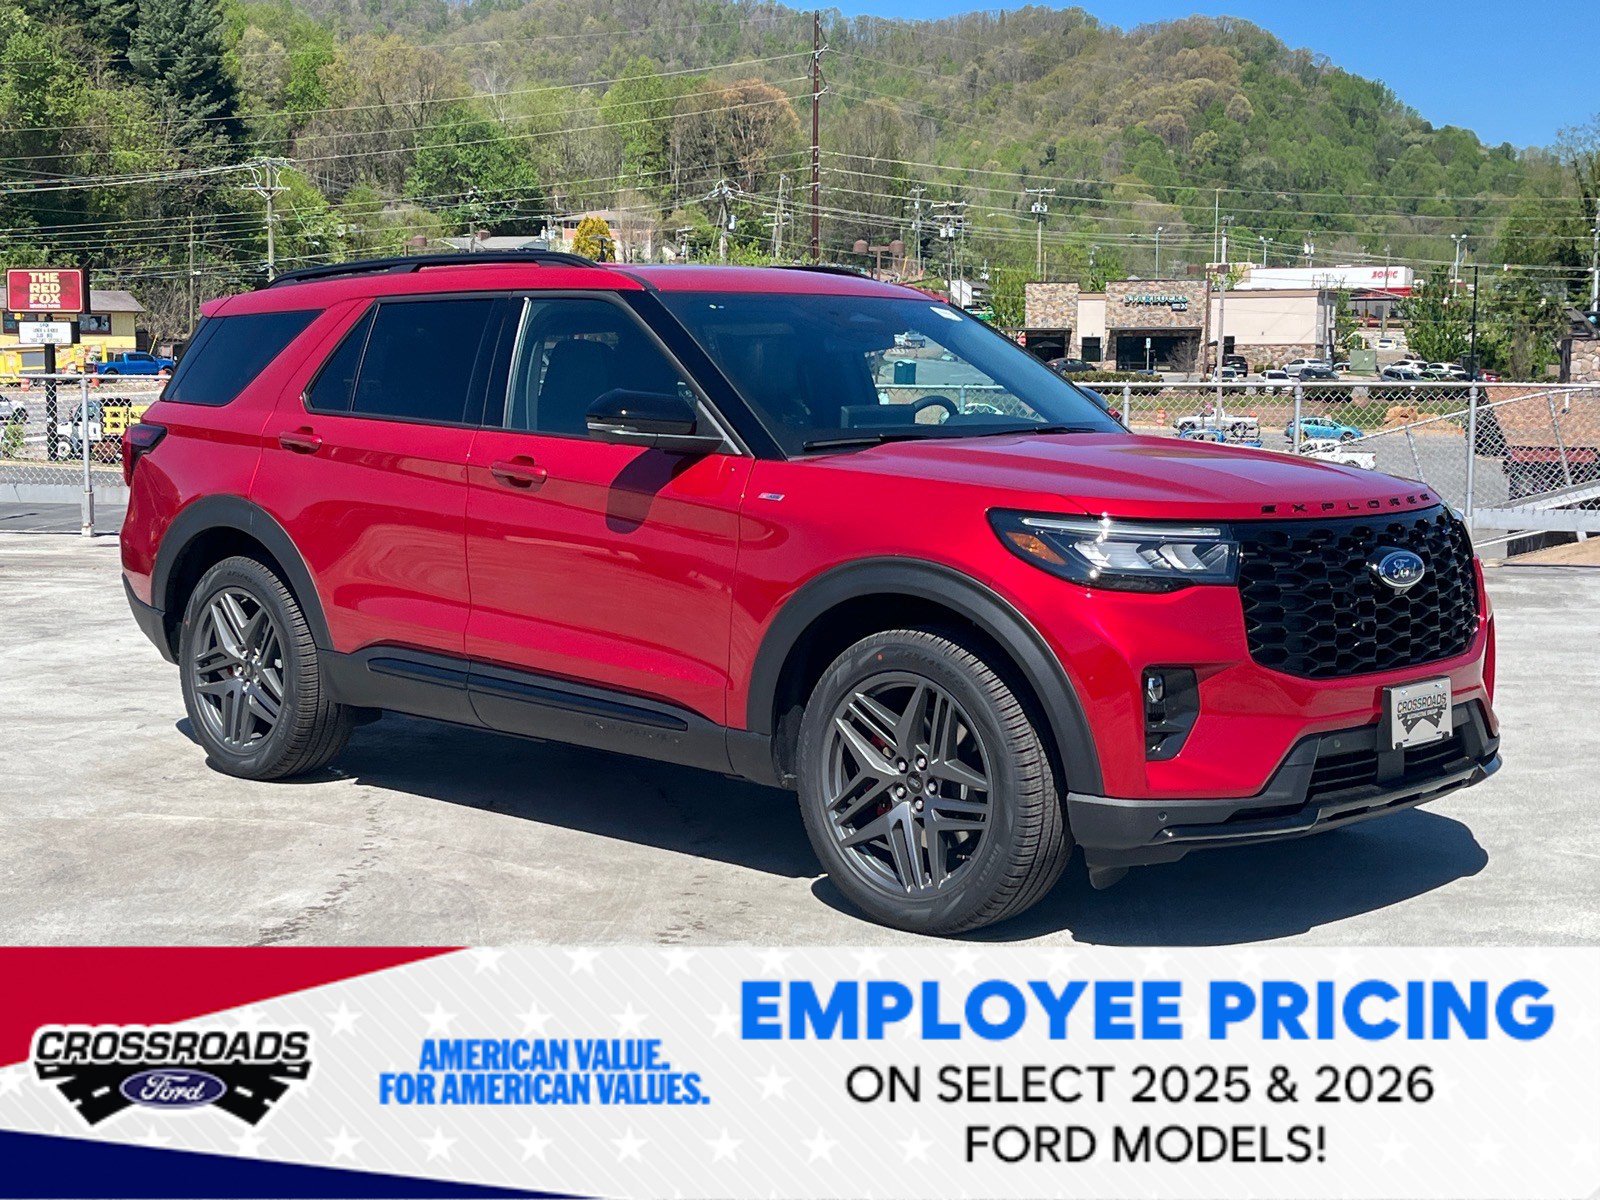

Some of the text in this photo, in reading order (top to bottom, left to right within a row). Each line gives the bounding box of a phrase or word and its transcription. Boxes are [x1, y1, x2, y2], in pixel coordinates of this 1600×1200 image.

[29, 272, 60, 283] THE
[1371, 270, 1399, 279] SONIC
[29, 283, 61, 294] RED
[29, 293, 61, 304] FOX
[1124, 293, 1189, 304] STARBUCKS
[1261, 493, 1430, 514] EXPLORER
[1392, 558, 1417, 579] Ford
[1397, 693, 1447, 713] CROSSROADS
